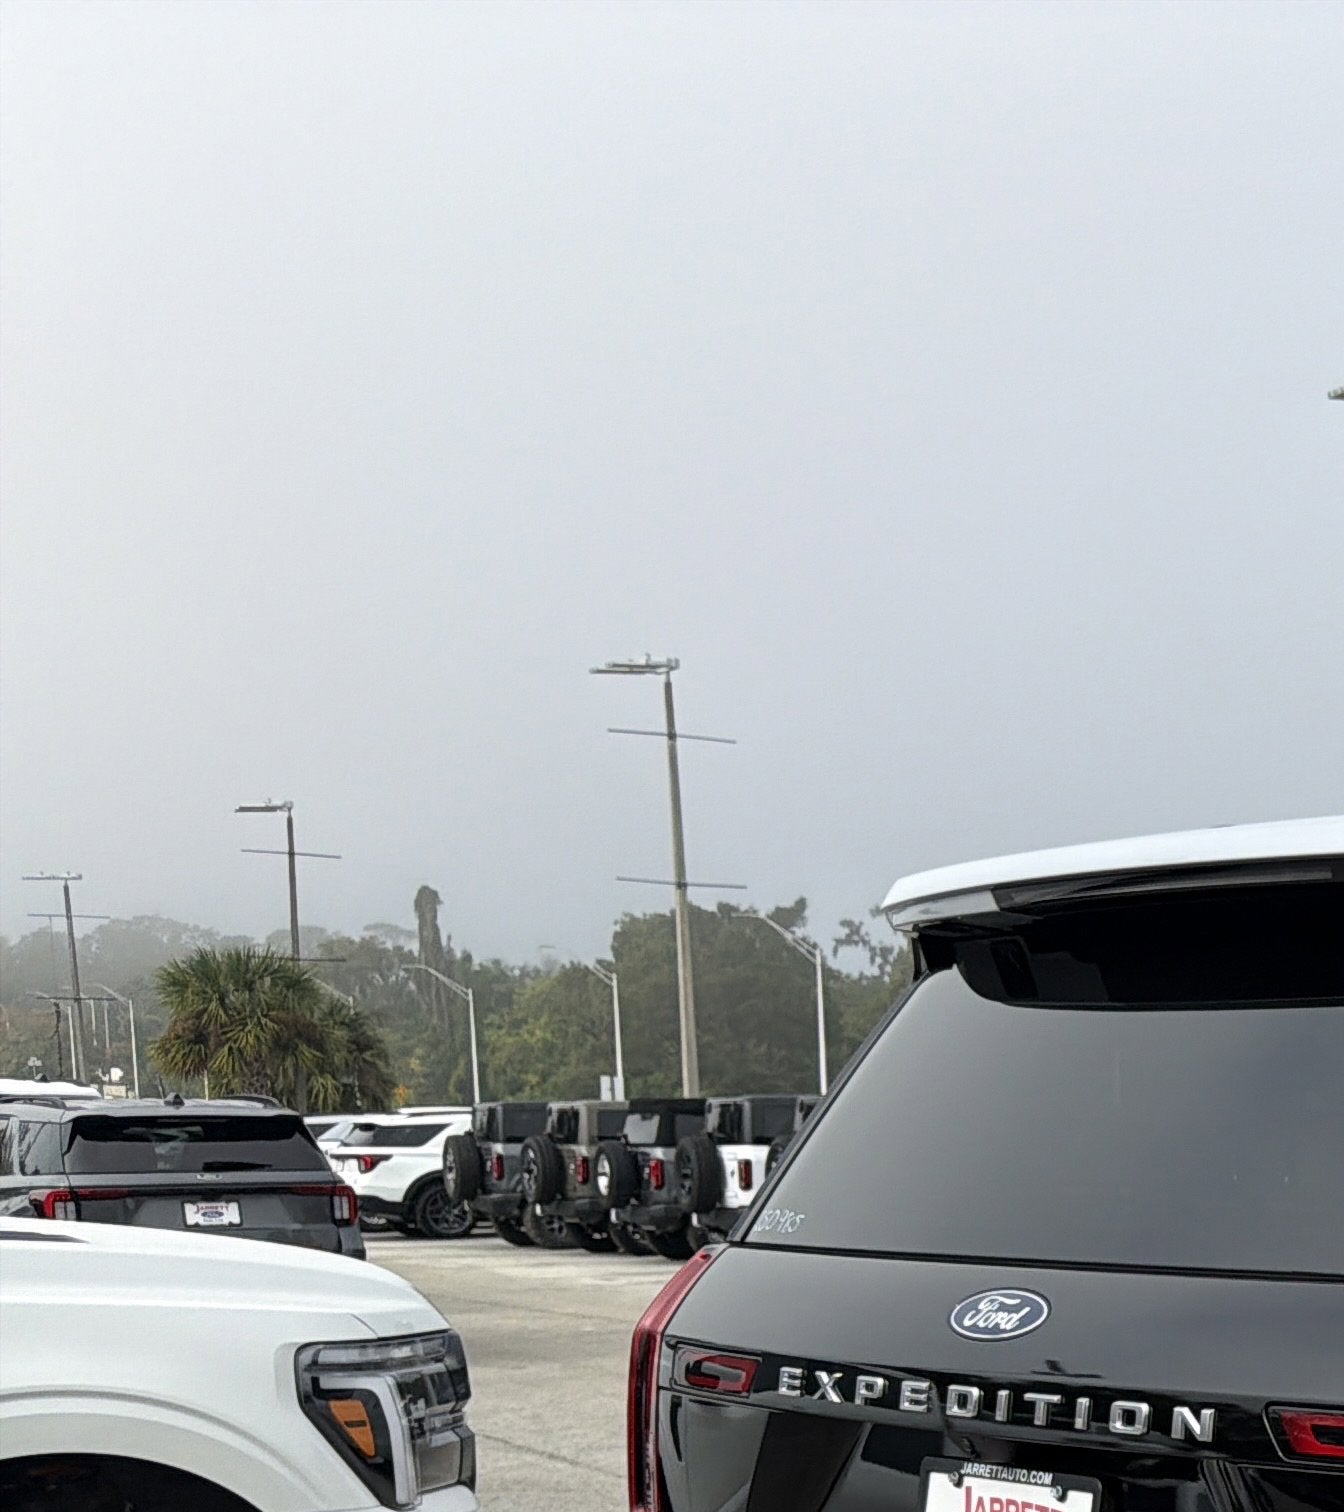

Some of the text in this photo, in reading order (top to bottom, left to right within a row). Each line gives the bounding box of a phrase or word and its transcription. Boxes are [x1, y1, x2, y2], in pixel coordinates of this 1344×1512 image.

[962, 1295, 1031, 1331] Ford
[778, 1365, 1218, 1443] EXPEDITION
[960, 1462, 1053, 1485] JARRETTAUTO.COM
